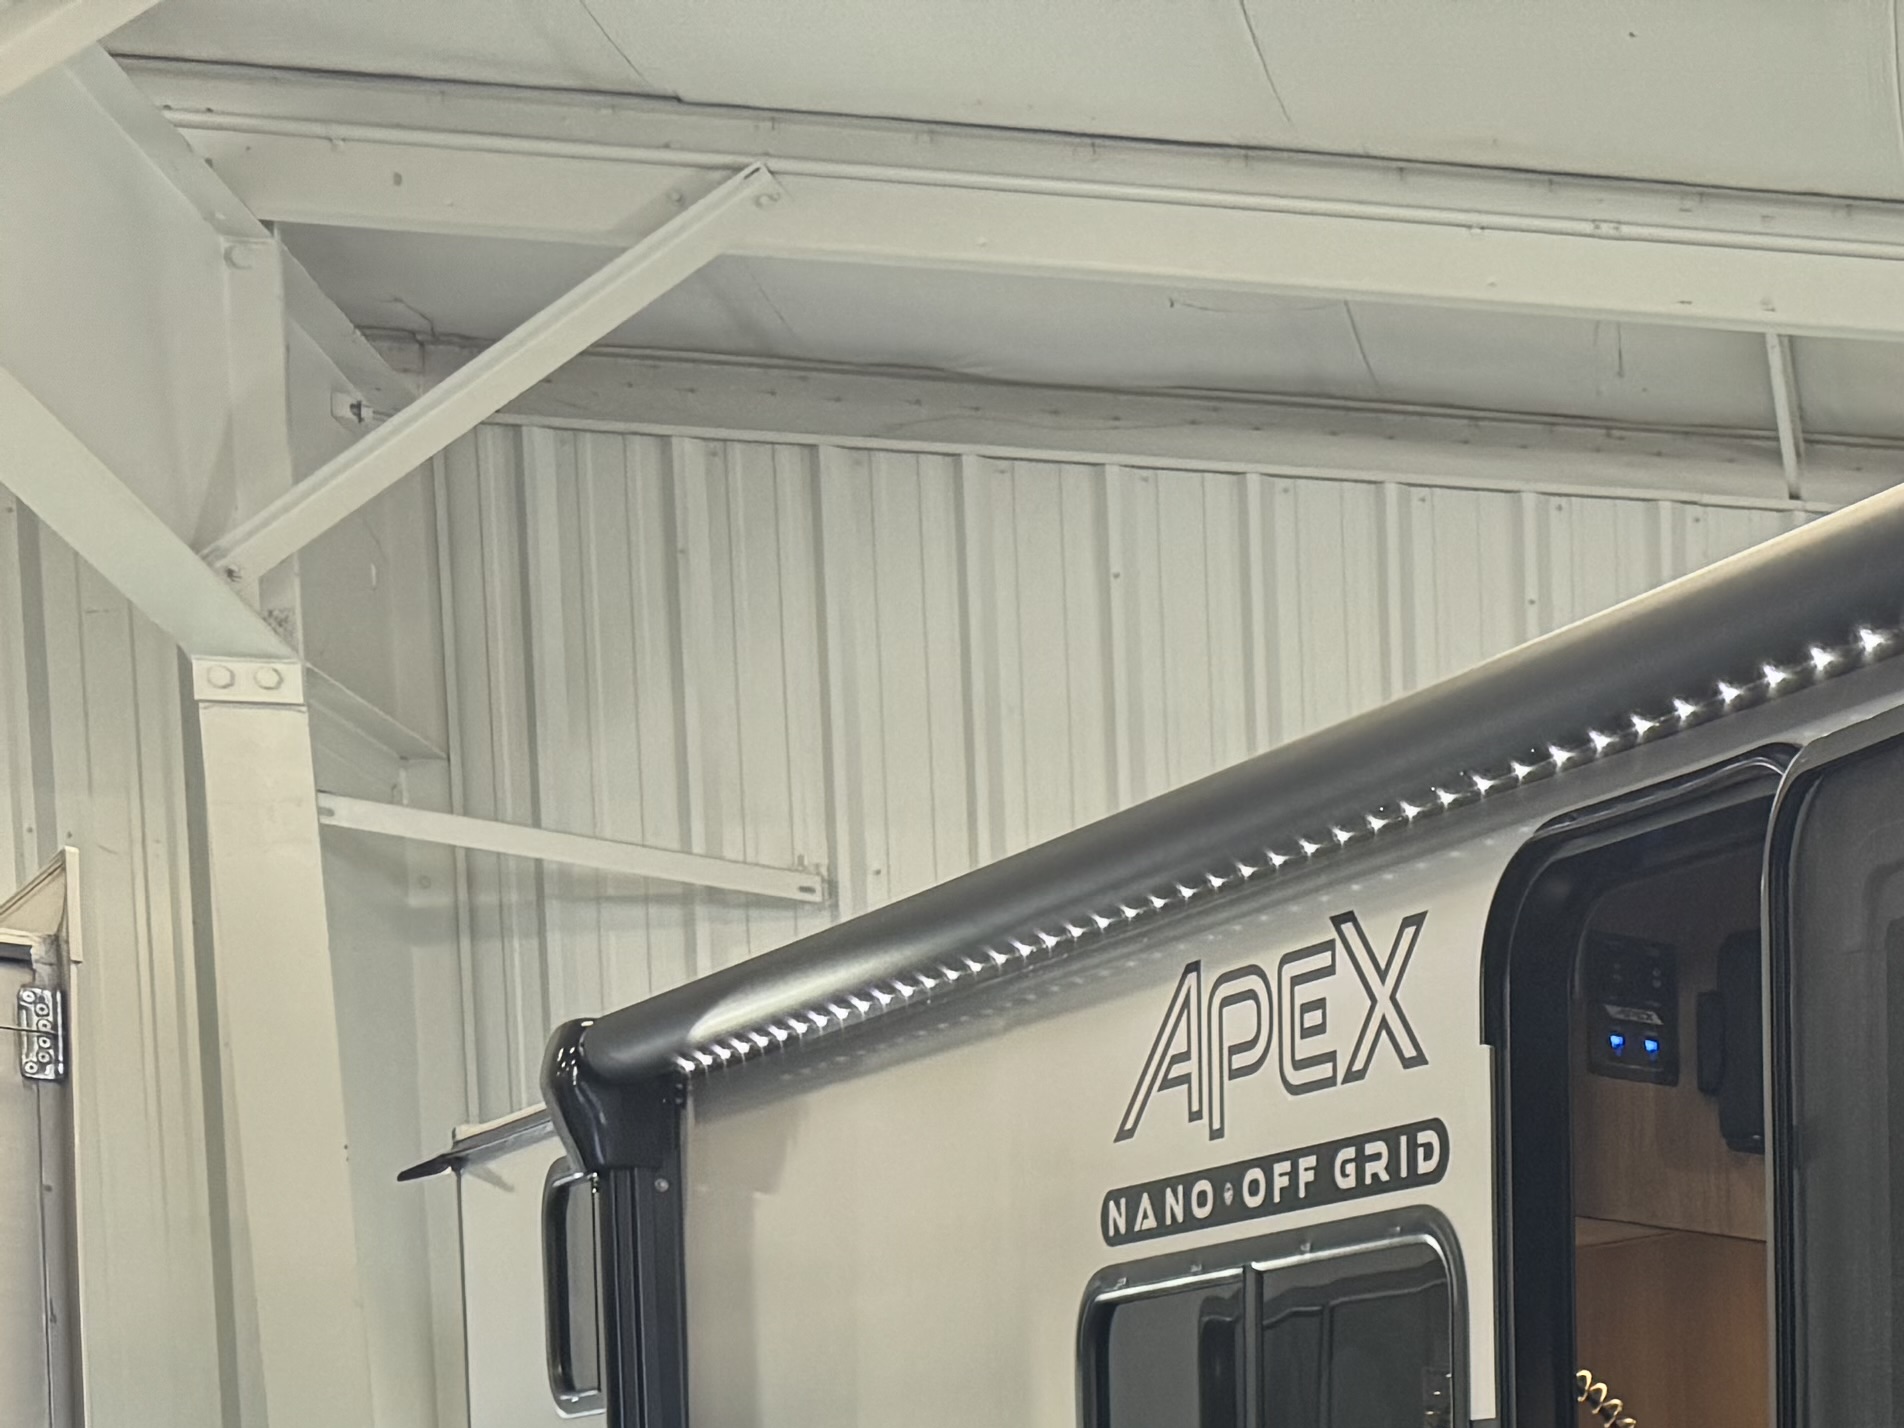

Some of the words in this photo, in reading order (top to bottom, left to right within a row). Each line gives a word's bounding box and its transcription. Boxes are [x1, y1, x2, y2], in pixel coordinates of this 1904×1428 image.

[1113, 910, 1429, 1144] APEX
[1107, 1179, 1214, 1237] NANO
[1241, 1155, 1318, 1209] OFF
[1333, 1129, 1442, 1188] GRID
